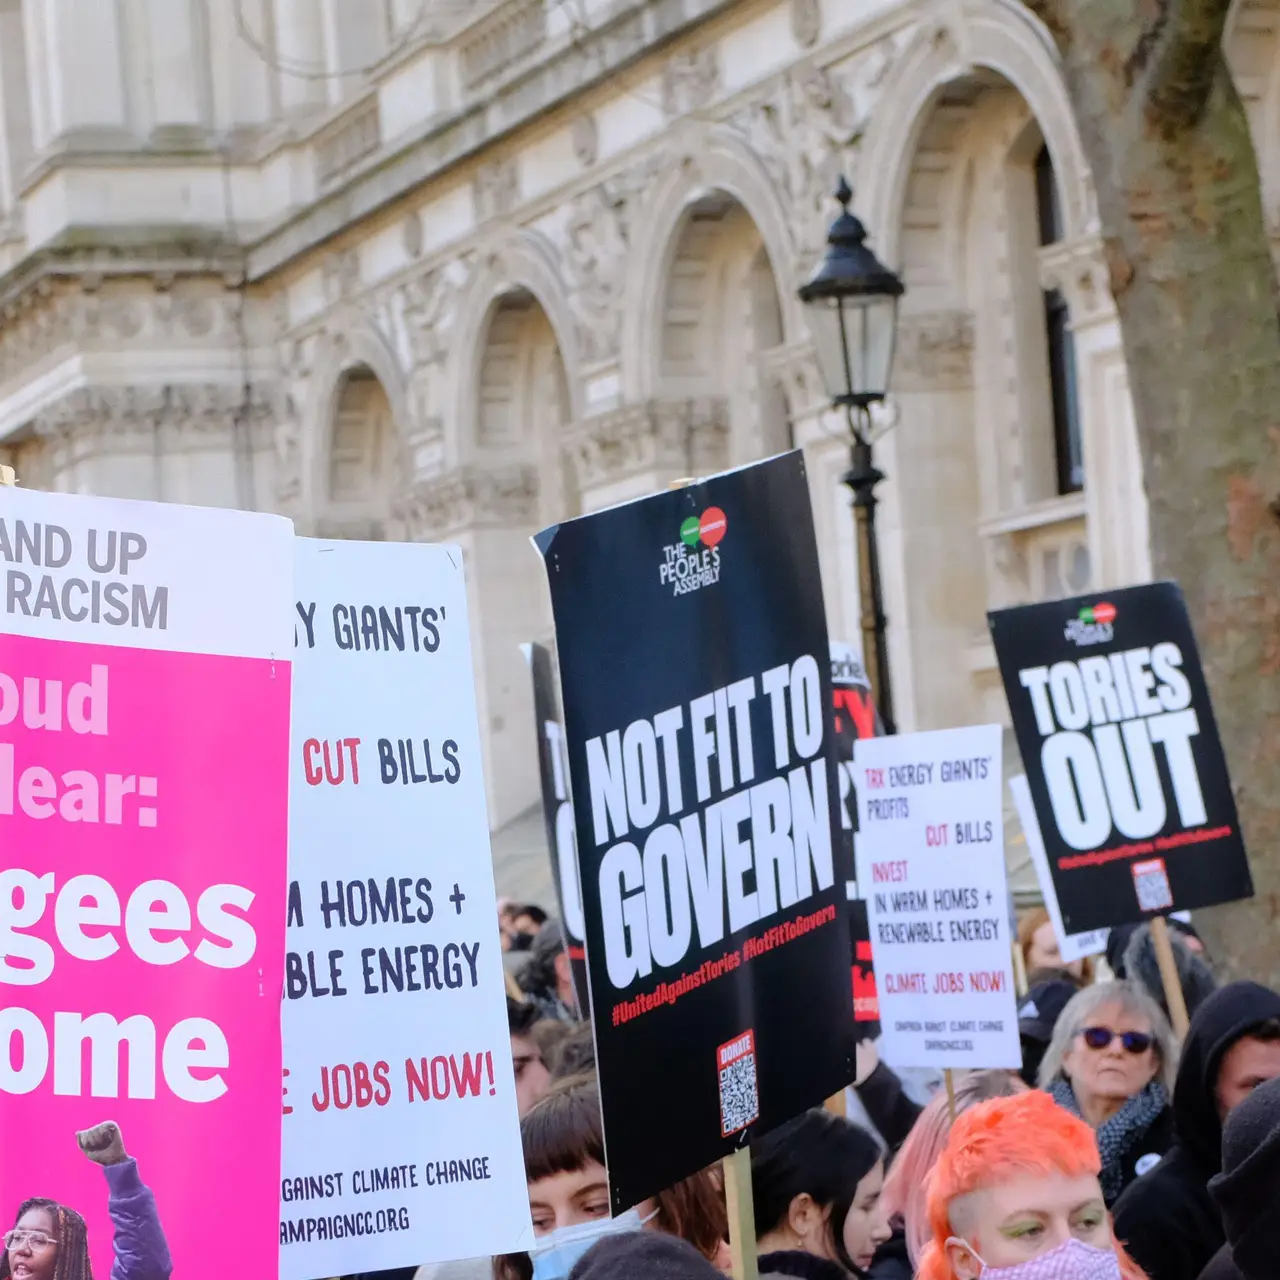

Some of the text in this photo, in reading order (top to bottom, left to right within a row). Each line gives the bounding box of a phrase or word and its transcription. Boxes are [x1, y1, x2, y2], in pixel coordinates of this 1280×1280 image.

[86, 528, 148, 576] UP
[663, 542, 687, 562] THE
[5, 570, 169, 630] RACISM
[673, 566, 720, 597] ASSEMBLY
[1019, 641, 1193, 737] TORIES
[303, 737, 461, 786] CUT BILLS
[585, 705, 684, 846] NOT
[690, 676, 756, 804] FIT
[762, 654, 824, 770] TO
[865, 768, 885, 790] TAX
[889, 762, 934, 788] ENERGY
[1041, 708, 1208, 851] OUT
[867, 797, 909, 821] PROFITS
[925, 821, 993, 847] CUT BILLS
[598, 757, 835, 990] GOVERN
[872, 861, 908, 883] INVEST
[320, 876, 435, 929] HOMES
[874, 893, 887, 914] IN
[890, 890, 928, 914] WARM
[933, 887, 979, 911] HOMES
[878, 918, 1000, 945] RENEWABLE ENERGY
[282, 941, 481, 1000] BLE ENERGY
[612, 903, 836, 1027] #UnitedAgainstTories #NotFitToGovern
[885, 969, 1006, 995] CLIMATE JOBS NOW!
[311, 1060, 391, 1113] JOBS
[405, 1050, 496, 1104] NOW!
[280, 1156, 491, 1202] GAINST CLIMATE CHANGE
[280, 1206, 410, 1245] AMPAIGNCC.ORG
